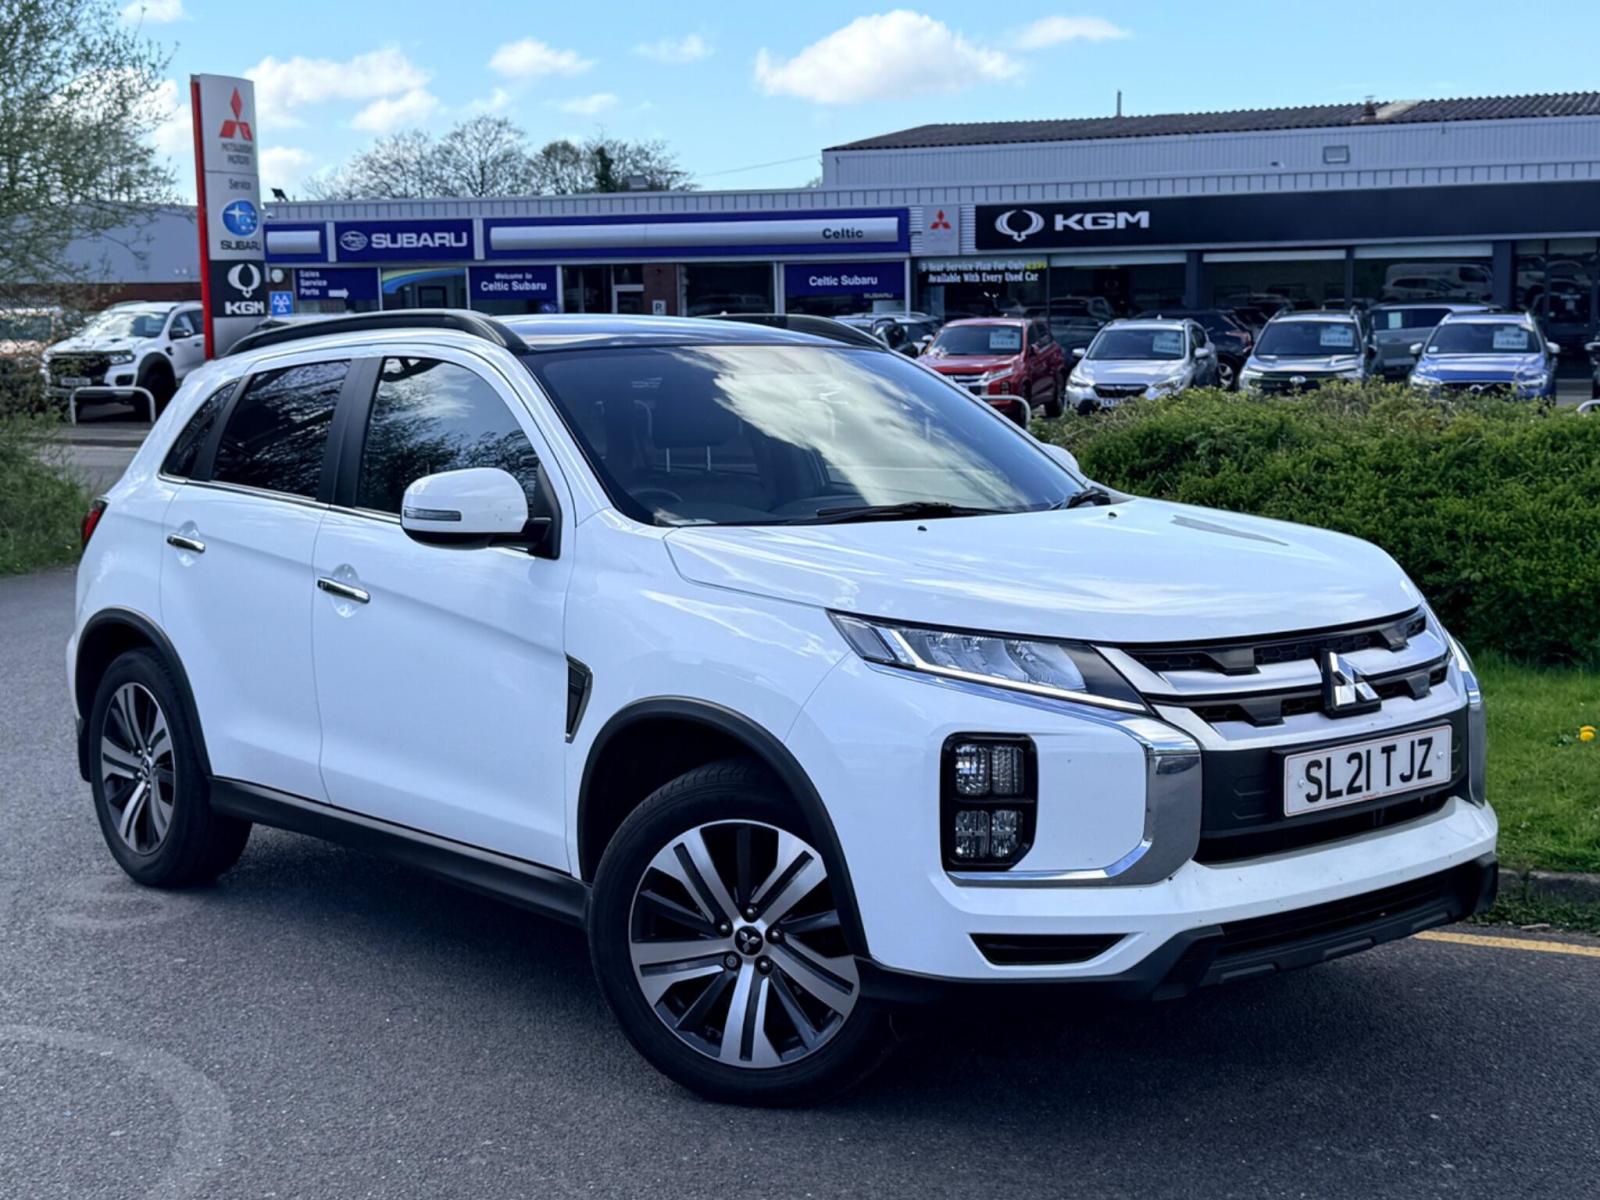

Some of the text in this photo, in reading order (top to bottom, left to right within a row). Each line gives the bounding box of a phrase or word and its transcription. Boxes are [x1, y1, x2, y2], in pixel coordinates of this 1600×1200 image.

[1054, 211, 1150, 231] KGM
[822, 227, 863, 239] Celtic
[371, 232, 468, 248] SUBARU
[299, 270, 320, 278] Sales
[495, 272, 523, 280] Welcome
[928, 271, 1039, 283] Available With Every Used Car
[299, 279, 328, 287] Service
[480, 281, 547, 292] Celtic Subaru
[808, 275, 878, 287] Celtic Subaru
[299, 288, 320, 296] Parts
[224, 301, 265, 315] KGM
[1304, 736, 1434, 803] SL21 TJZ
